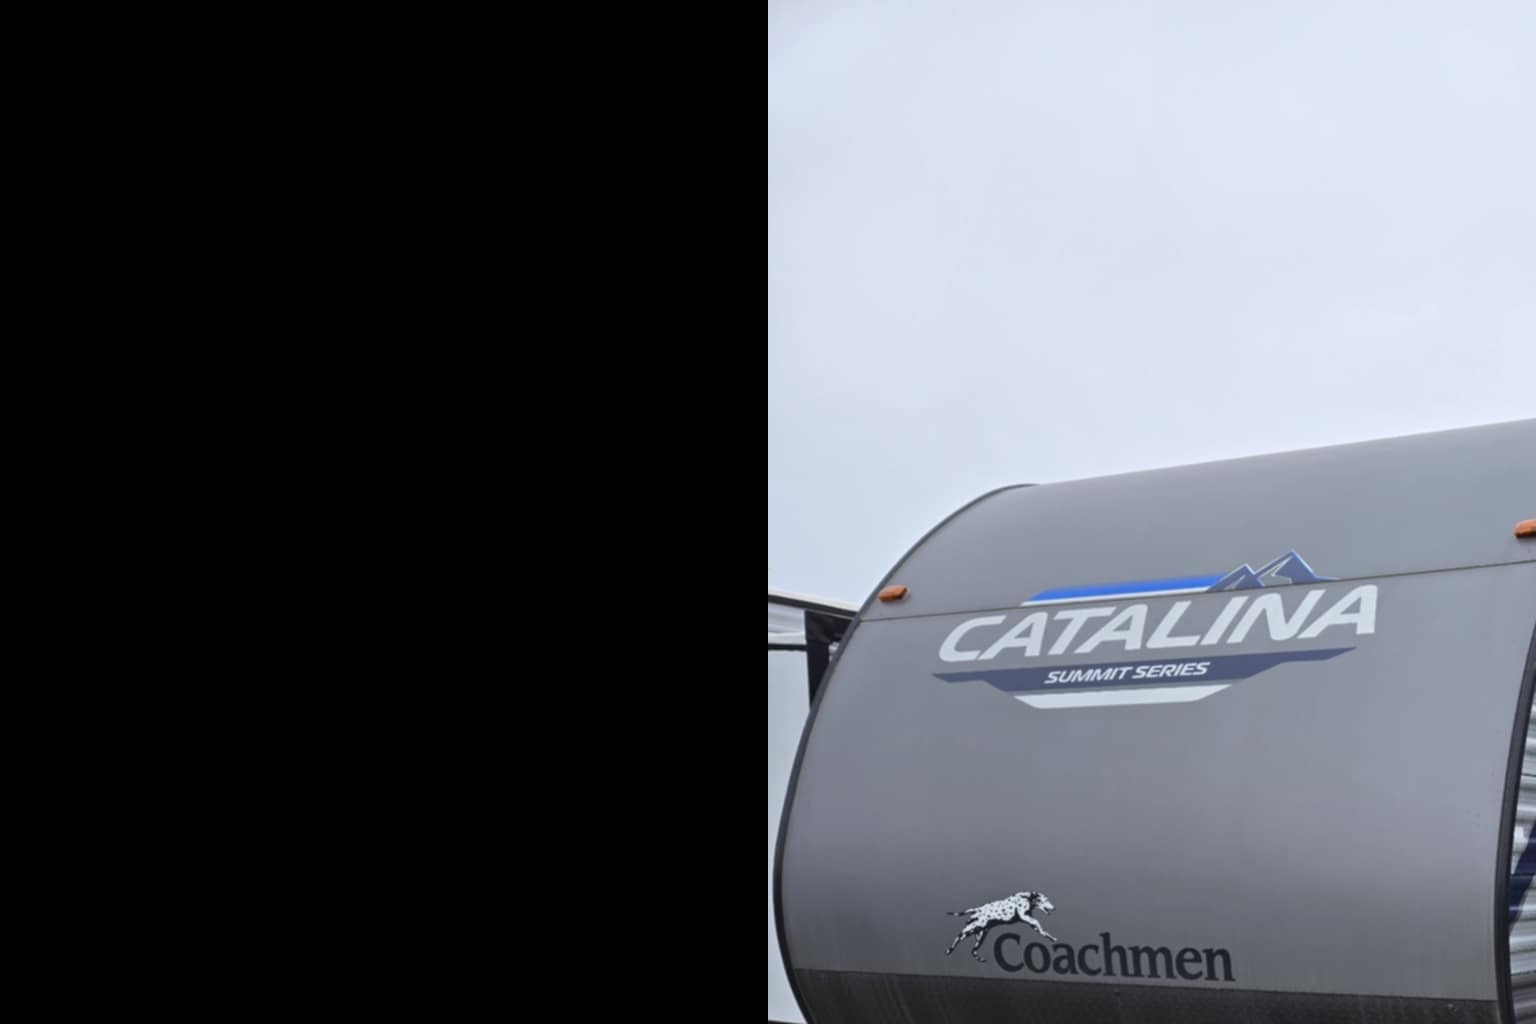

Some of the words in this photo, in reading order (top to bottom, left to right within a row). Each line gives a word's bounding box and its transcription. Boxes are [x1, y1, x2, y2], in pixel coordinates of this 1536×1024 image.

[938, 585, 1379, 663] CATALINA
[1044, 666, 1134, 685] SUMMIT
[1131, 661, 1211, 680] SERIES
[993, 932, 1236, 982] Coachmen
